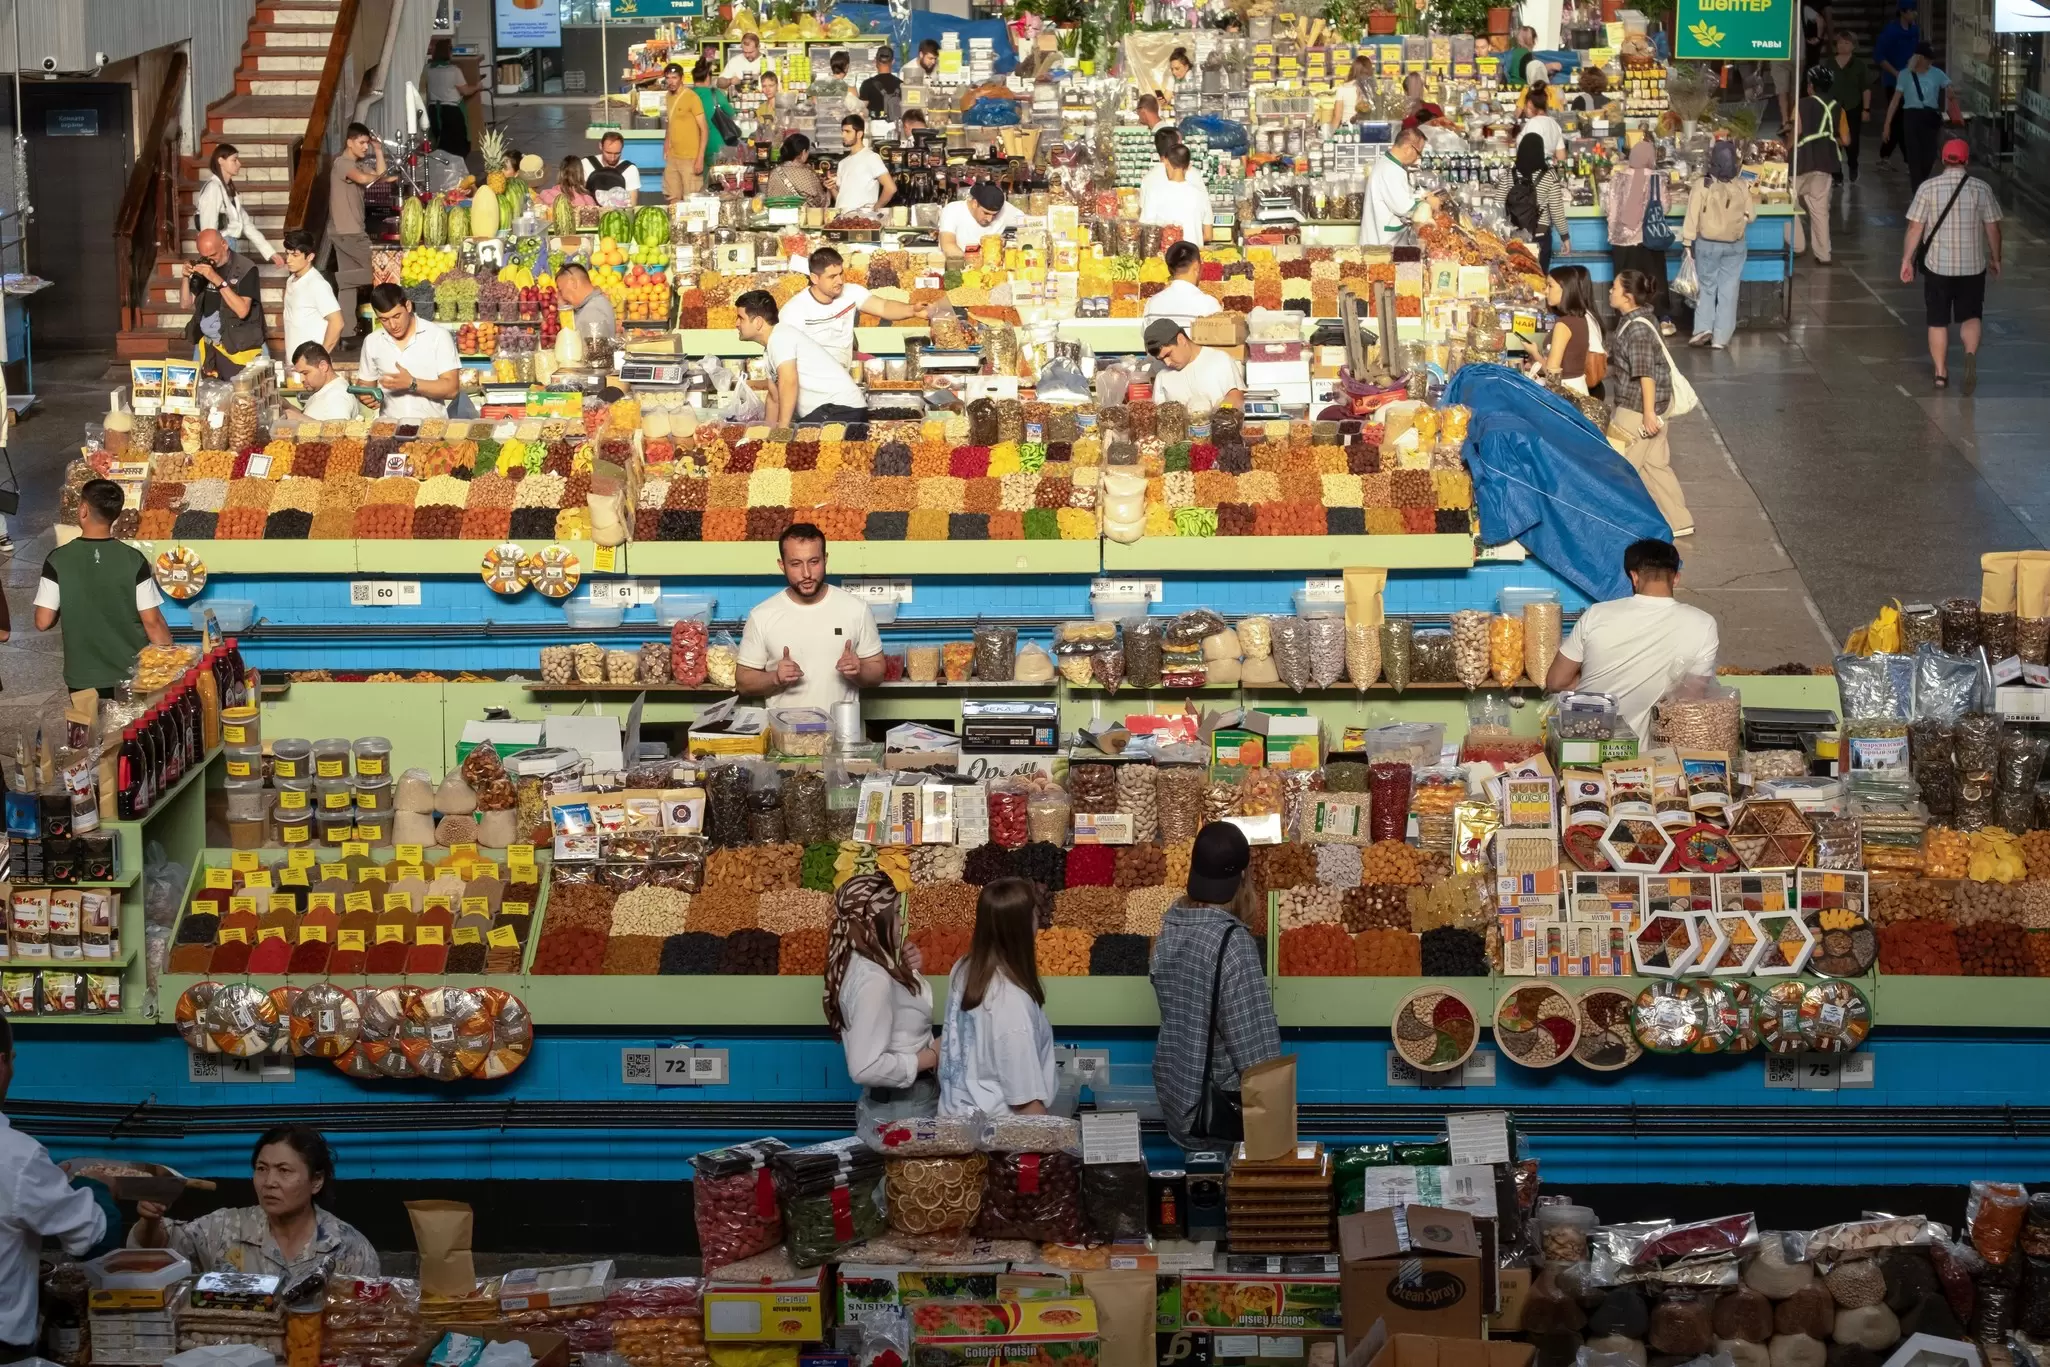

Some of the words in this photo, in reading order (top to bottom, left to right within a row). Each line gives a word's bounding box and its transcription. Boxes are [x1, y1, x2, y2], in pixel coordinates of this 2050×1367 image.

[1699, 0, 1772, 11] ШӨПТЕР
[1751, 40, 1782, 48] ТРАВЫ
[1516, 319, 1534, 328] ЧАЙ
[378, 588, 393, 598] 60
[619, 587, 631, 597] 61
[233, 1058, 251, 1072] 71
[664, 1060, 687, 1074] 72
[1808, 1063, 1832, 1078] 75
[1392, 1282, 1425, 1304] Ocean
[1424, 1283, 1457, 1305] Spray
[1239, 1315, 1270, 1325] Raisin
[1270, 1315, 1305, 1326] Golden
[965, 1346, 1002, 1358] Golden
[1004, 1345, 1037, 1357] Raisin
